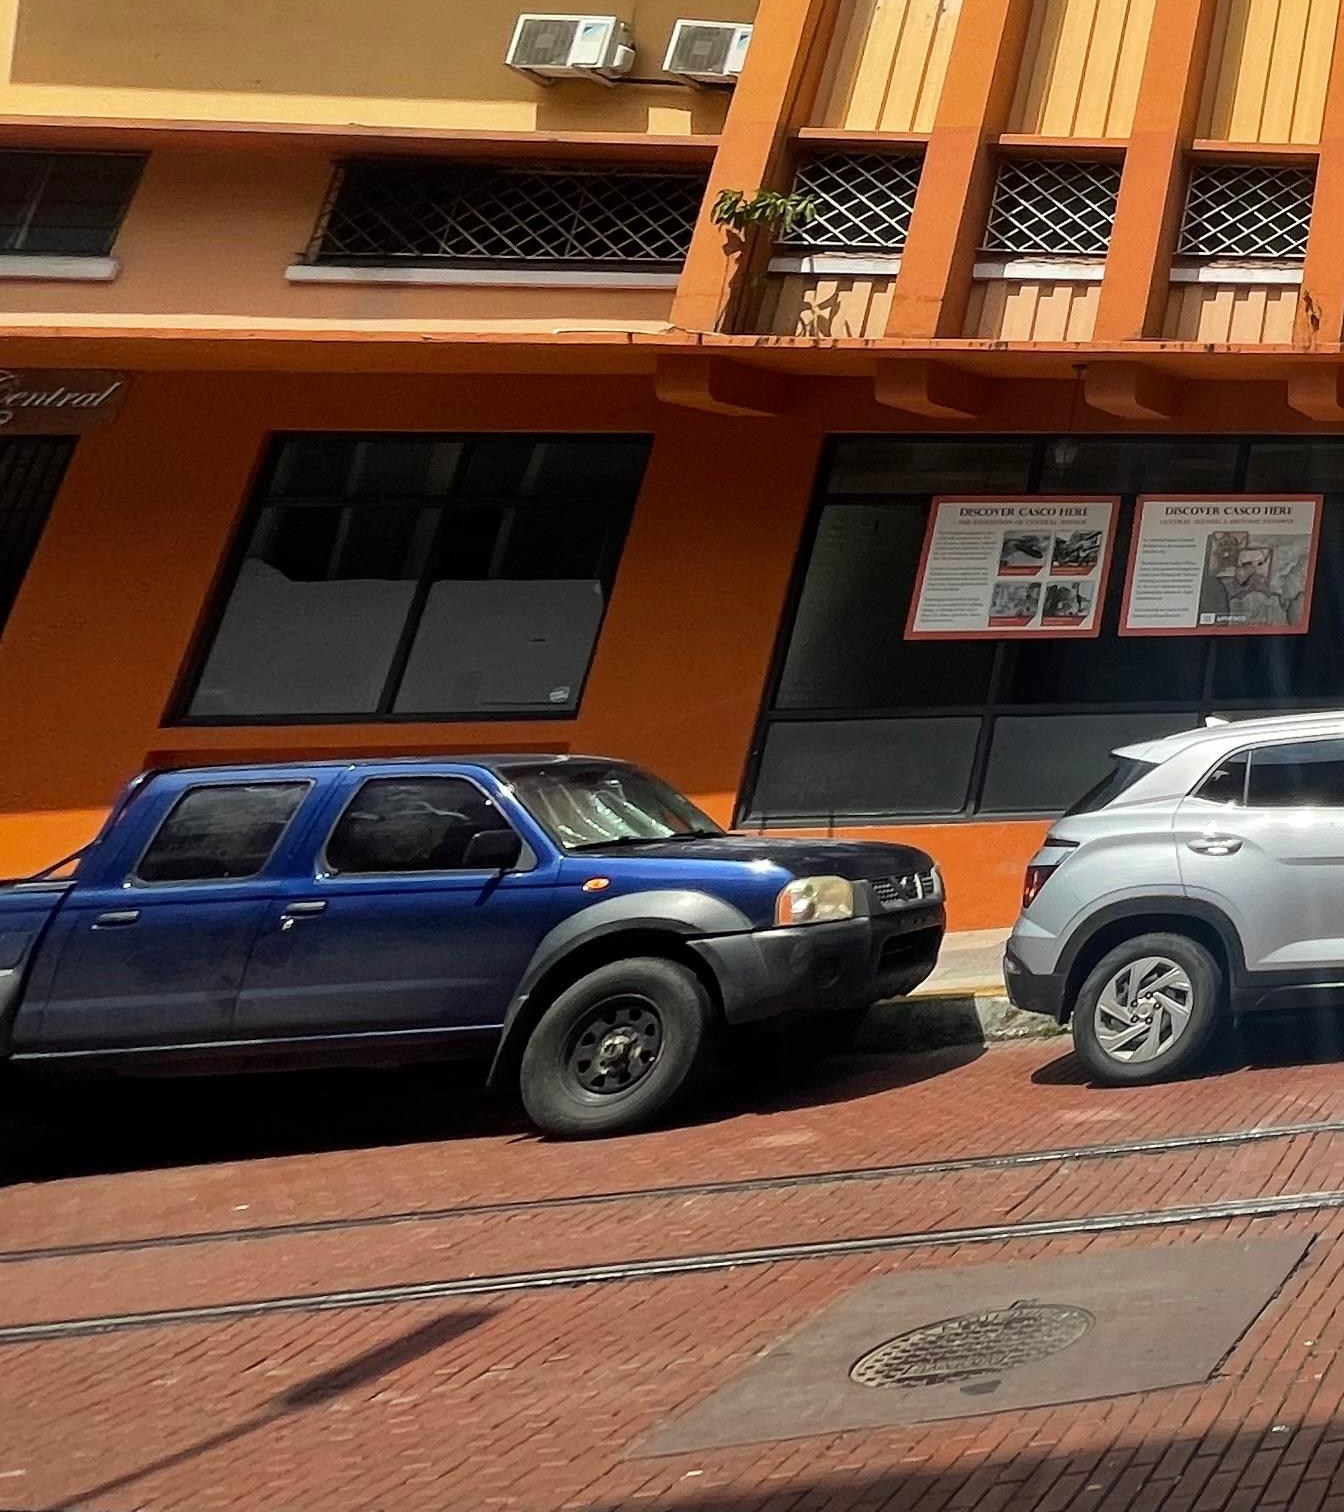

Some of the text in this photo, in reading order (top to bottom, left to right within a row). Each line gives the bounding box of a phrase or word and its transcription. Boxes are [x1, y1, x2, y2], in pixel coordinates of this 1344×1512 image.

[960, 507, 1014, 517] DISCOVER
[1019, 507, 1056, 517] CASCO
[1165, 506, 1219, 515] DISCOVER
[1223, 506, 1260, 515] CASCO
